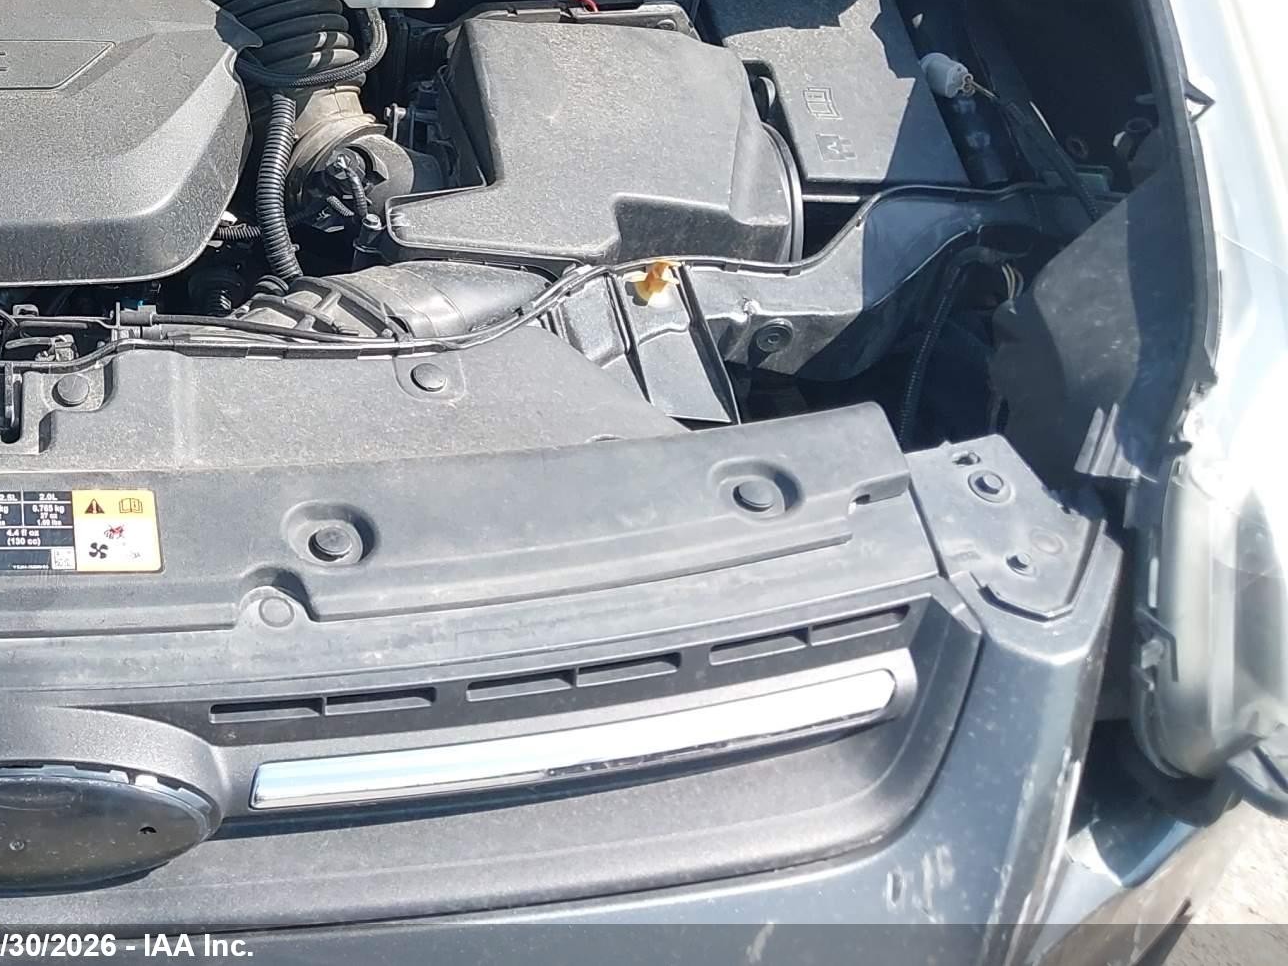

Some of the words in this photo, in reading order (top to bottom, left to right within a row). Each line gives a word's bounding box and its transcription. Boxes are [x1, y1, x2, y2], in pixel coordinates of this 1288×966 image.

[0, 493, 18, 502] 2.5L
[39, 493, 58, 501] 2.0L
[0, 504, 9, 514] kg
[54, 504, 65, 515] kg
[27, 538, 41, 546] cc)
